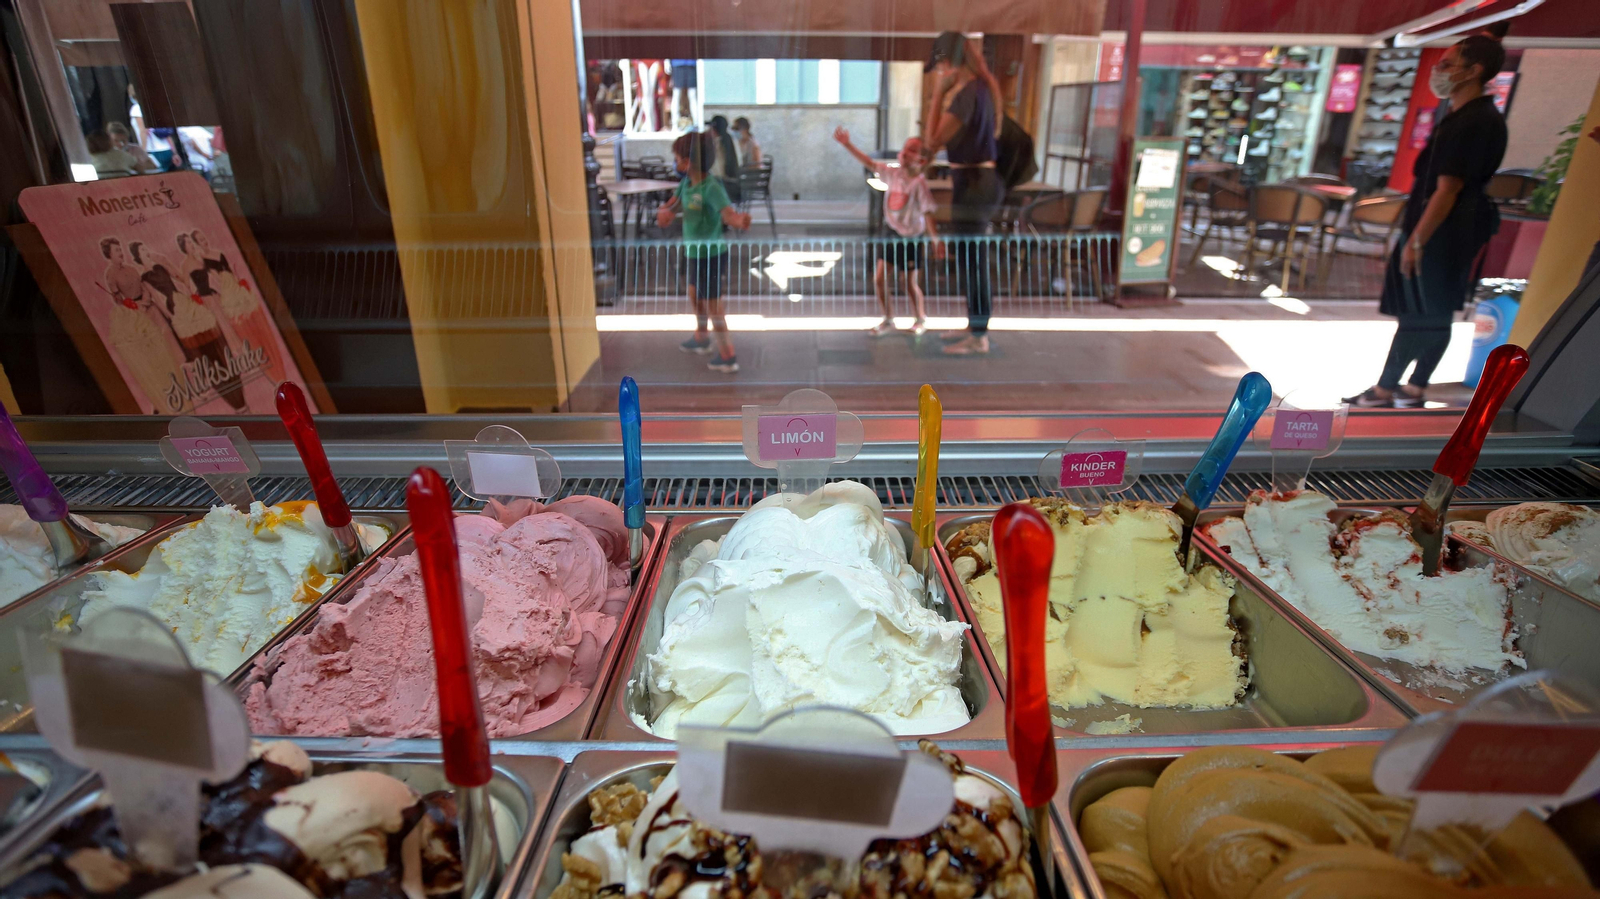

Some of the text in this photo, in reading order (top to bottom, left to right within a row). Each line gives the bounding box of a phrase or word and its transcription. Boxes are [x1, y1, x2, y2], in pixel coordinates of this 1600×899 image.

[77, 188, 165, 217] Monerris
[164, 338, 270, 413] Milkshake
[1286, 421, 1319, 431] TARTA
[770, 429, 825, 445] LIMÓN
[184, 447, 230, 457] YOGURT
[186, 456, 240, 464] BANANA-MANGO
[1070, 461, 1116, 472] KINDER
